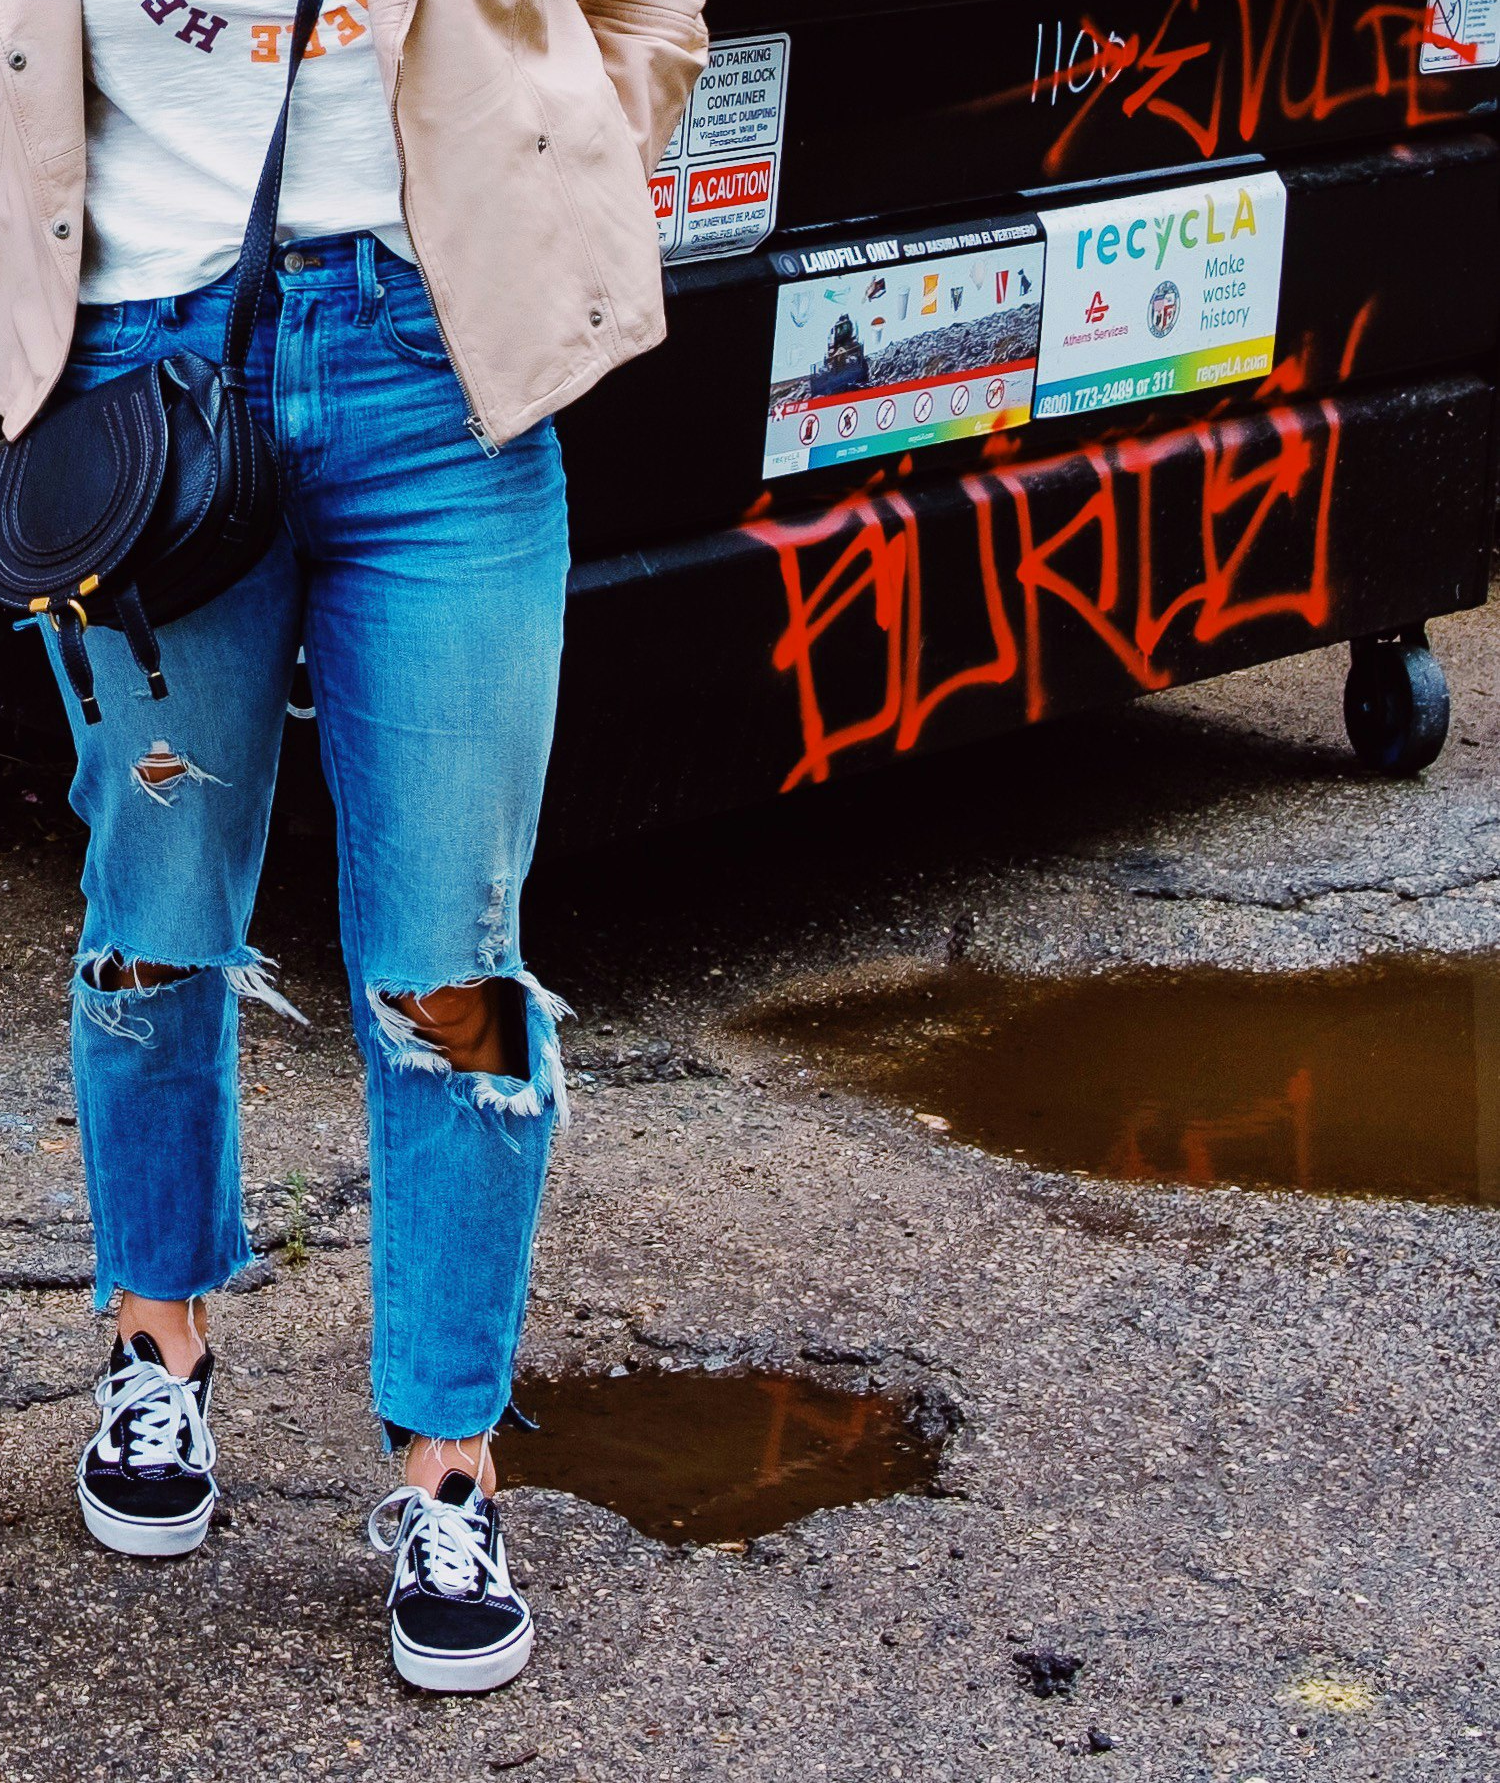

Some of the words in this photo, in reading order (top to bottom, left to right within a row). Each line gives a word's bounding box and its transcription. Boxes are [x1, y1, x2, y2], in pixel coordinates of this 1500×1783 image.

[708, 54, 724, 69] NO
[726, 47, 771, 66] PARKING
[700, 75, 715, 90] DO
[718, 72, 739, 88] NOT
[742, 67, 776, 84] BLOCK
[707, 89, 766, 110] CONTAINER
[692, 117, 706, 128] NO
[707, 112, 737, 126] PUBLIC
[739, 107, 776, 122] DUMPING
[700, 129, 736, 139] Violators
[739, 124, 754, 133] Will
[757, 123, 768, 131] Be
[709, 133, 757, 147] Prosecuted
[706, 169, 768, 202] CAUTION
[1076, 188, 1257, 271] recycLA
[800, 245, 867, 274] LANDFILL
[866, 239, 900, 263] ONLY
[903, 242, 926, 257] SOLO
[926, 237, 959, 254] BASURA
[959, 233, 981, 248] PARA
[981, 231, 994, 244] EL
[994, 224, 1038, 242] VERTEDERO
[1204, 254, 1245, 279] Make
[1203, 280, 1246, 303] waste
[1200, 305, 1251, 331] history
[1062, 332, 1092, 348] Athens
[1094, 324, 1129, 341] Services
[1196, 353, 1268, 384] recycLA.com
[1039, 390, 1071, 415] (800)
[1074, 380, 1134, 411] 773-2489
[1136, 378, 1150, 394] or
[1152, 368, 1175, 393] 311
